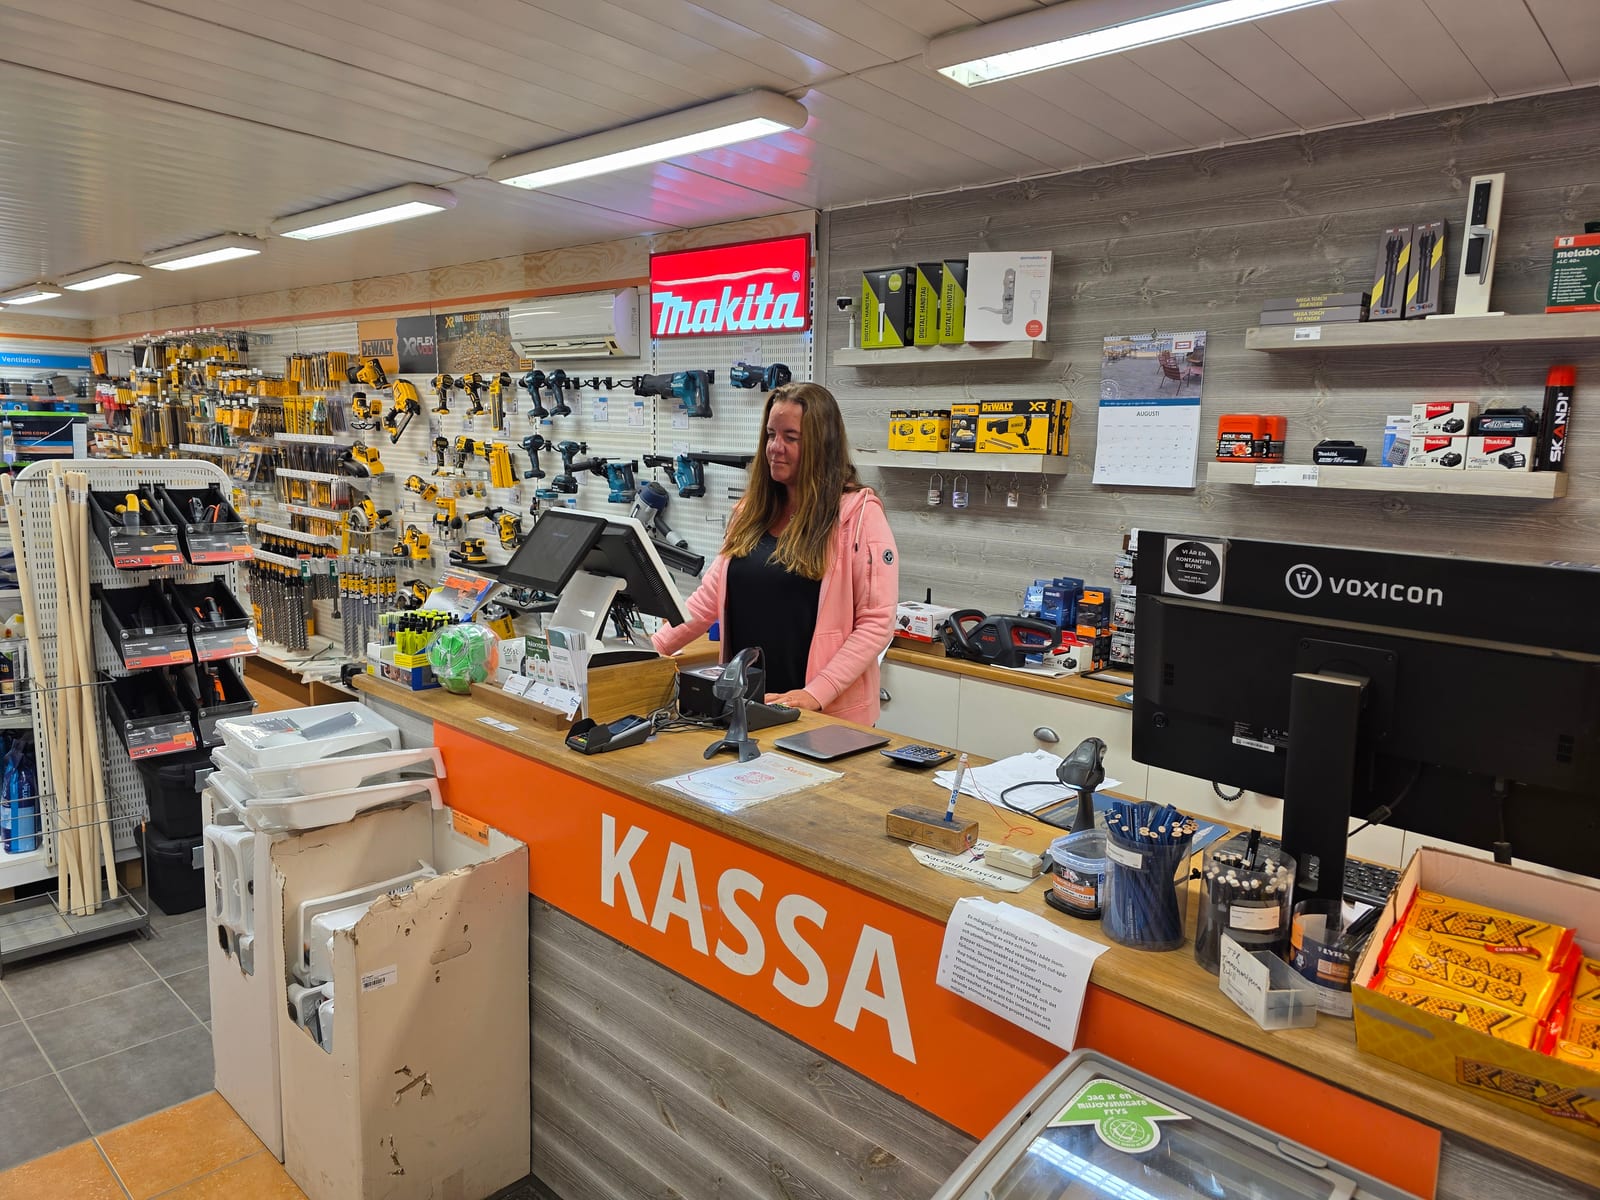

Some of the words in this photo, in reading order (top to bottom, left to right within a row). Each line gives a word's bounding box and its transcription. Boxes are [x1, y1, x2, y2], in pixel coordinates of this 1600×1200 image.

[1556, 247, 1600, 259] metabo
[652, 282, 805, 335] Makita
[416, 336, 434, 346] FLEX
[417, 345, 434, 355] VOLT
[1, 356, 41, 364] Ventilation
[1028, 401, 1048, 411] XR
[1549, 395, 1570, 463] SKANDI
[1176, 556, 1212, 566] KONTANTFRI
[601, 812, 917, 1065] KASSA
[1415, 906, 1536, 948] KEX
[1322, 948, 1351, 960] LYRA
[1427, 941, 1522, 986] KRAM
[1451, 967, 1528, 1007] DIG!
[1463, 1058, 1588, 1115] KEX
